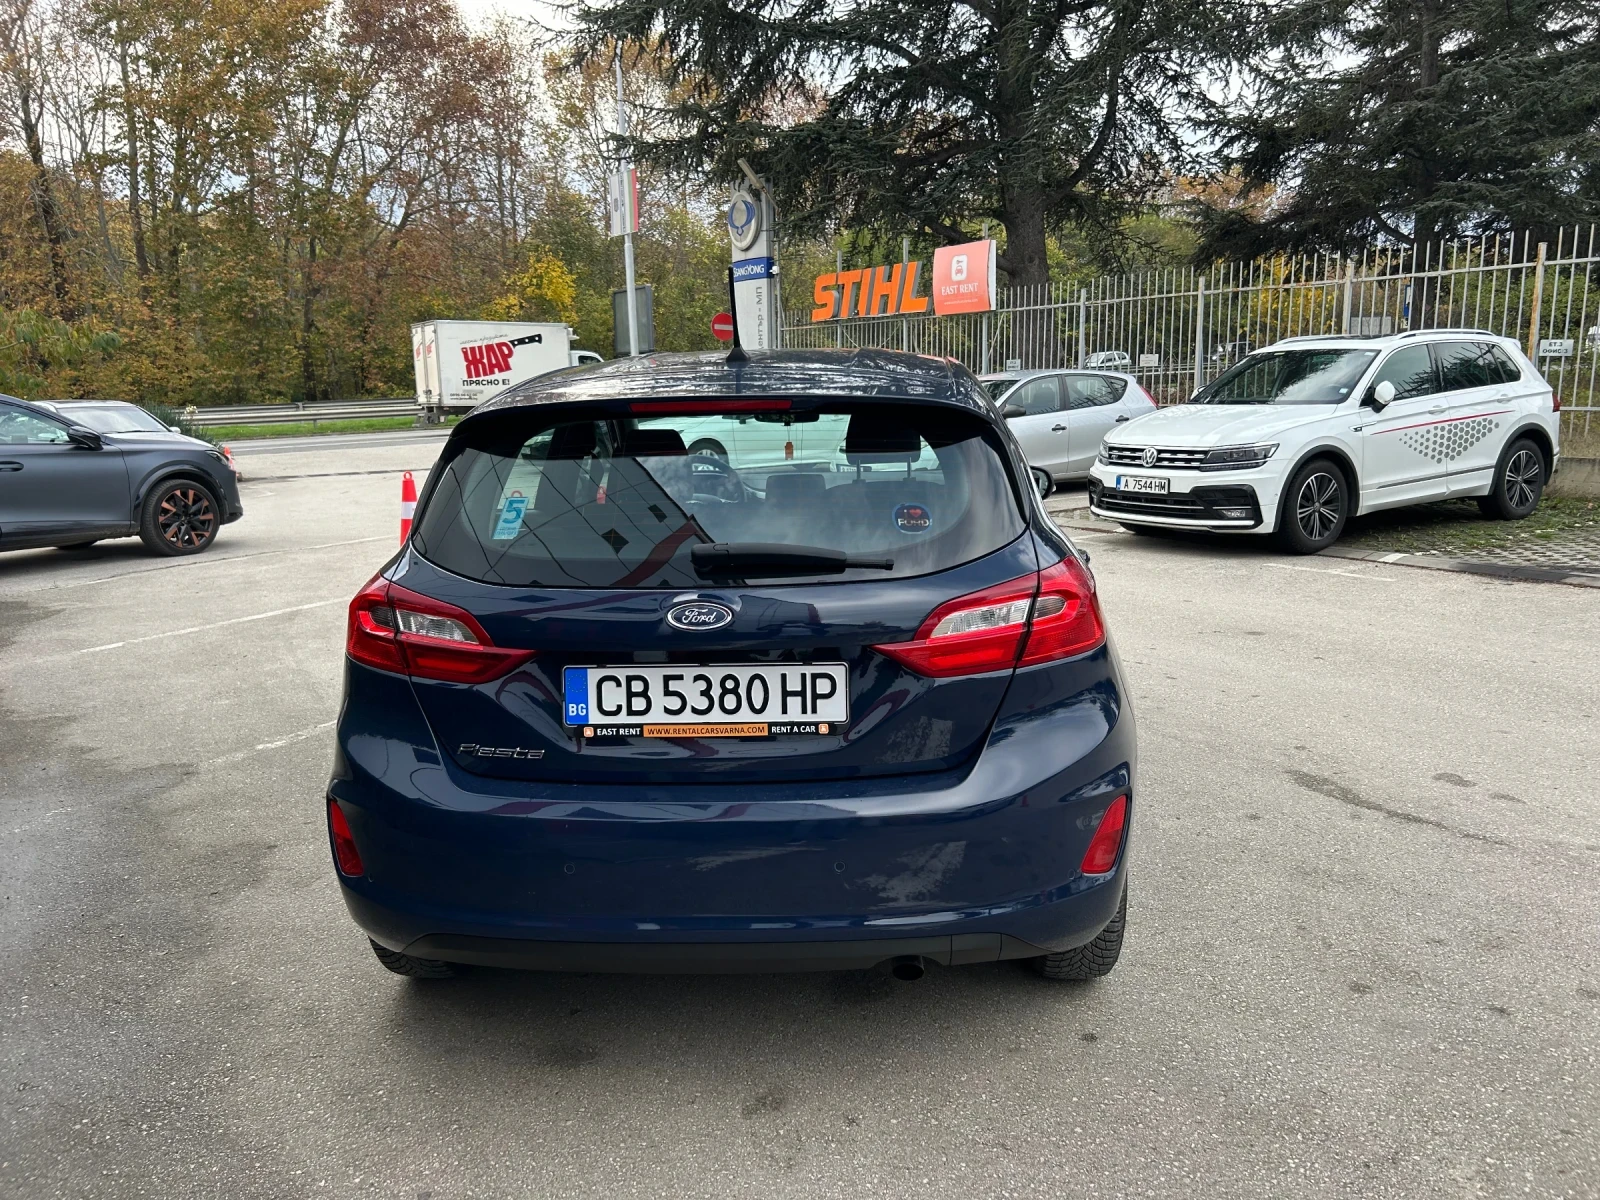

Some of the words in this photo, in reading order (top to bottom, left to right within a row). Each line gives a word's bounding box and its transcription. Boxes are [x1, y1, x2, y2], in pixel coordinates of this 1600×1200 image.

[812, 261, 929, 322] STIHL
[941, 284, 958, 296] EAST
[960, 282, 979, 294] RENT
[461, 341, 515, 379] ЖАР
[462, 378, 500, 386] ПРЯСНО
[502, 378, 510, 386] Е!
[1124, 479, 1129, 489] A
[1132, 479, 1153, 491] 7544
[1154, 480, 1166, 492] HM
[502, 500, 525, 524] 5
[681, 608, 717, 624] Ford
[596, 674, 653, 717] CB
[662, 672, 770, 716] 5380
[780, 672, 838, 715] HP
[568, 703, 587, 717] BG
[597, 728, 618, 736] EAST
[620, 727, 641, 736] RENT
[647, 726, 766, 736] WWW.RENTALCARSVARNA.COM
[771, 725, 791, 734] RENT
[793, 725, 799, 734] A
[800, 725, 816, 733] CAR
[457, 743, 545, 760] Fiesta
